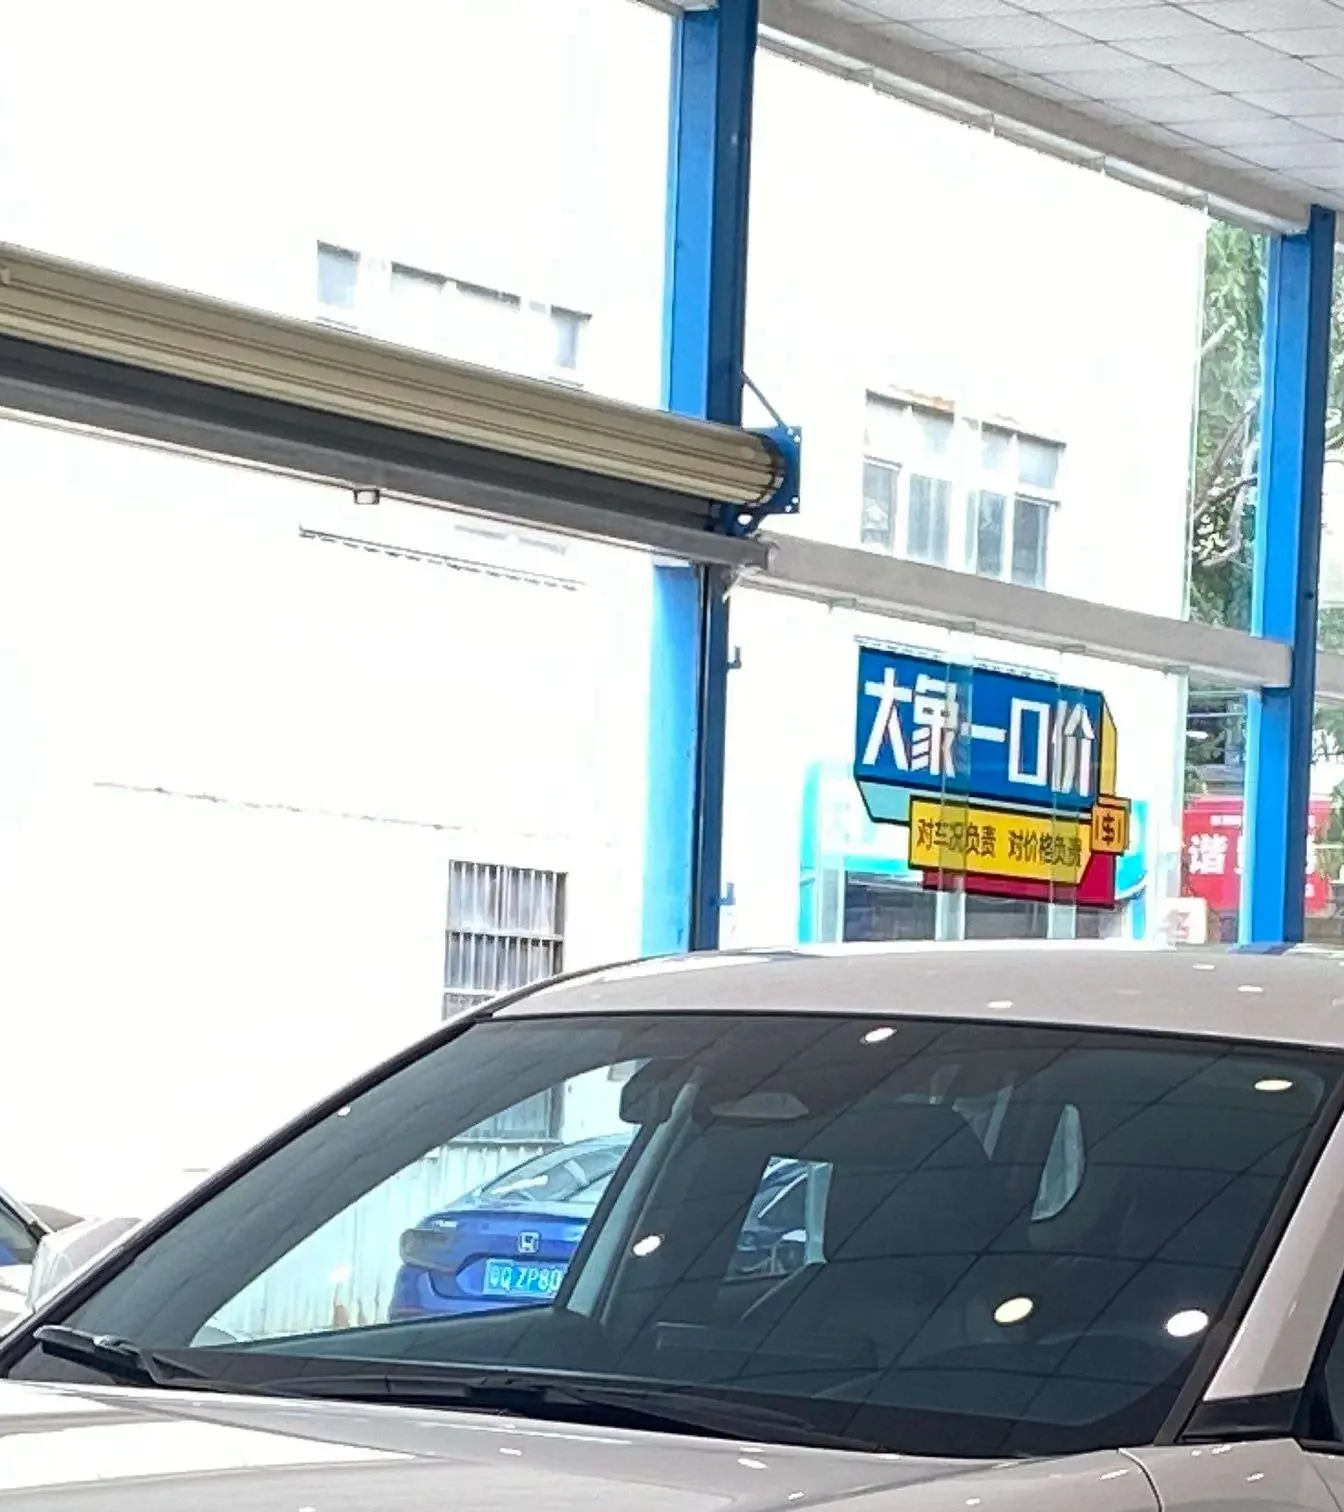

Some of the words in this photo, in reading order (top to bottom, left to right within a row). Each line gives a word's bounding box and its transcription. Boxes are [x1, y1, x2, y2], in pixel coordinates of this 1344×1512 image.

[862, 667, 1095, 797] 大象一口价
